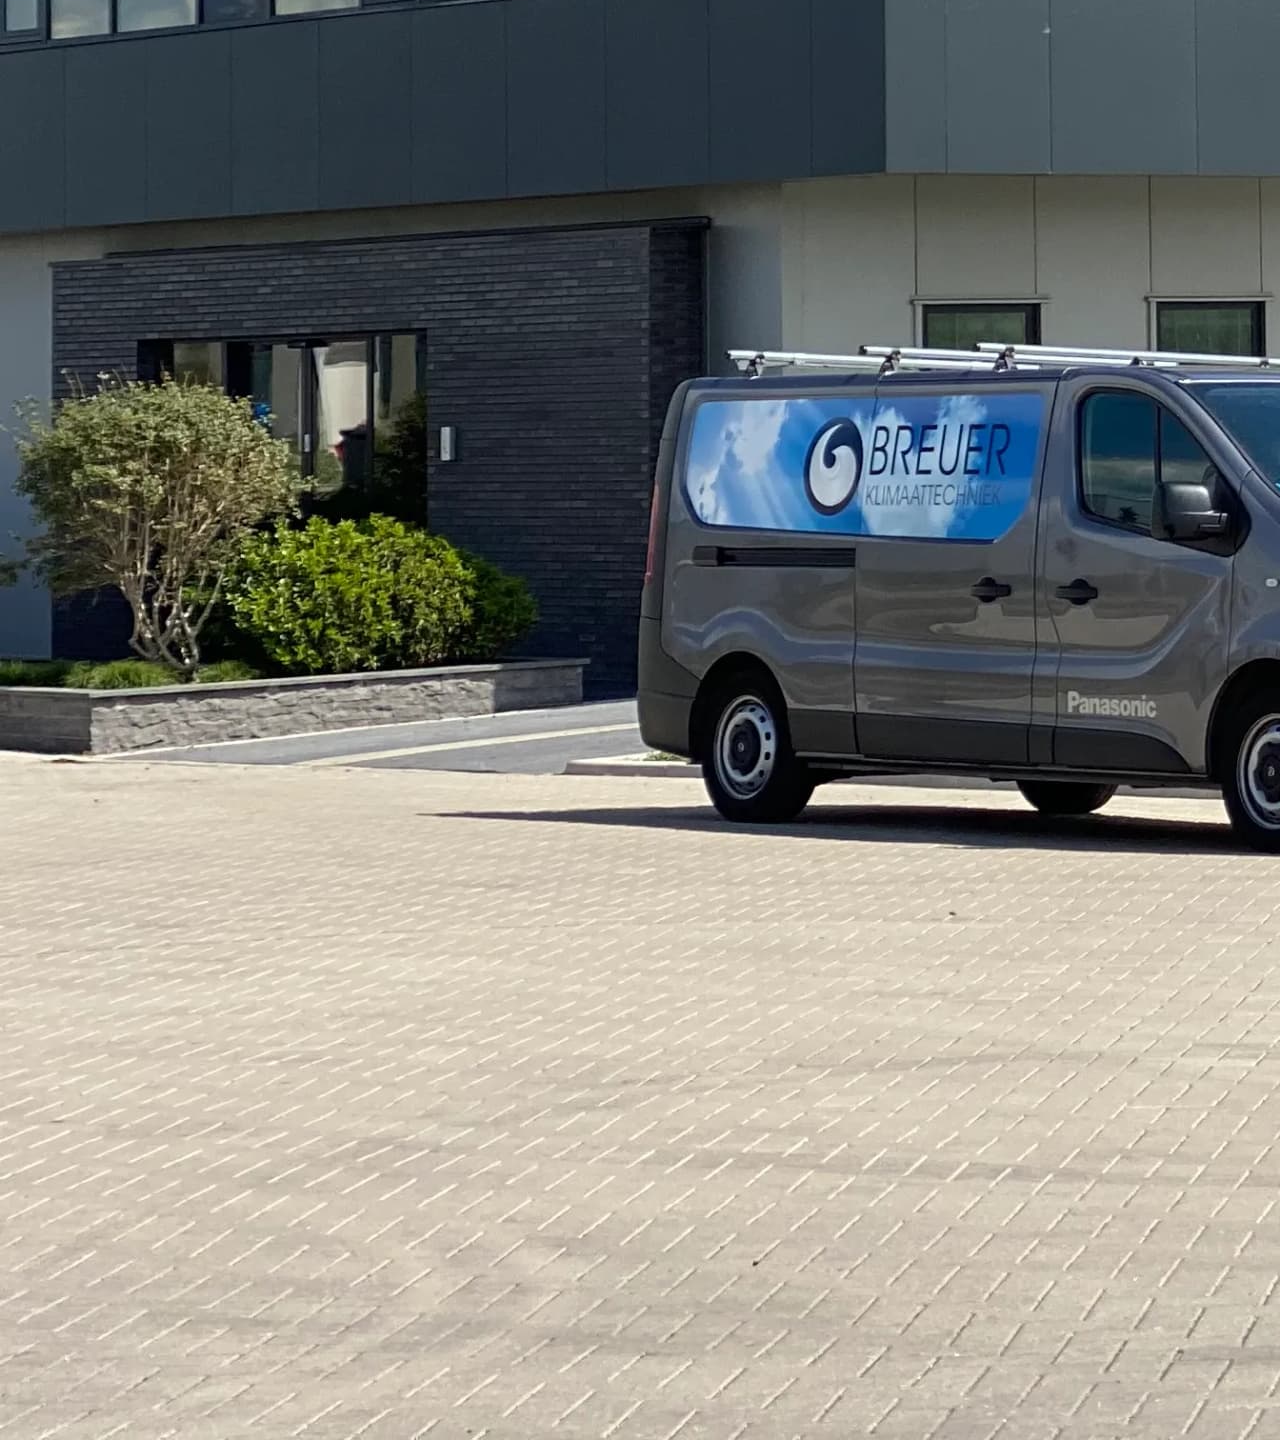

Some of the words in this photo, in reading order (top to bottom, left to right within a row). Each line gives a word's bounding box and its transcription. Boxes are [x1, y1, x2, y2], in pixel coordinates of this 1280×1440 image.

[869, 424, 1011, 476] BREUER
[865, 484, 1001, 506] KLIMAATTECHNIEK
[1067, 691, 1157, 718] Panasonic
